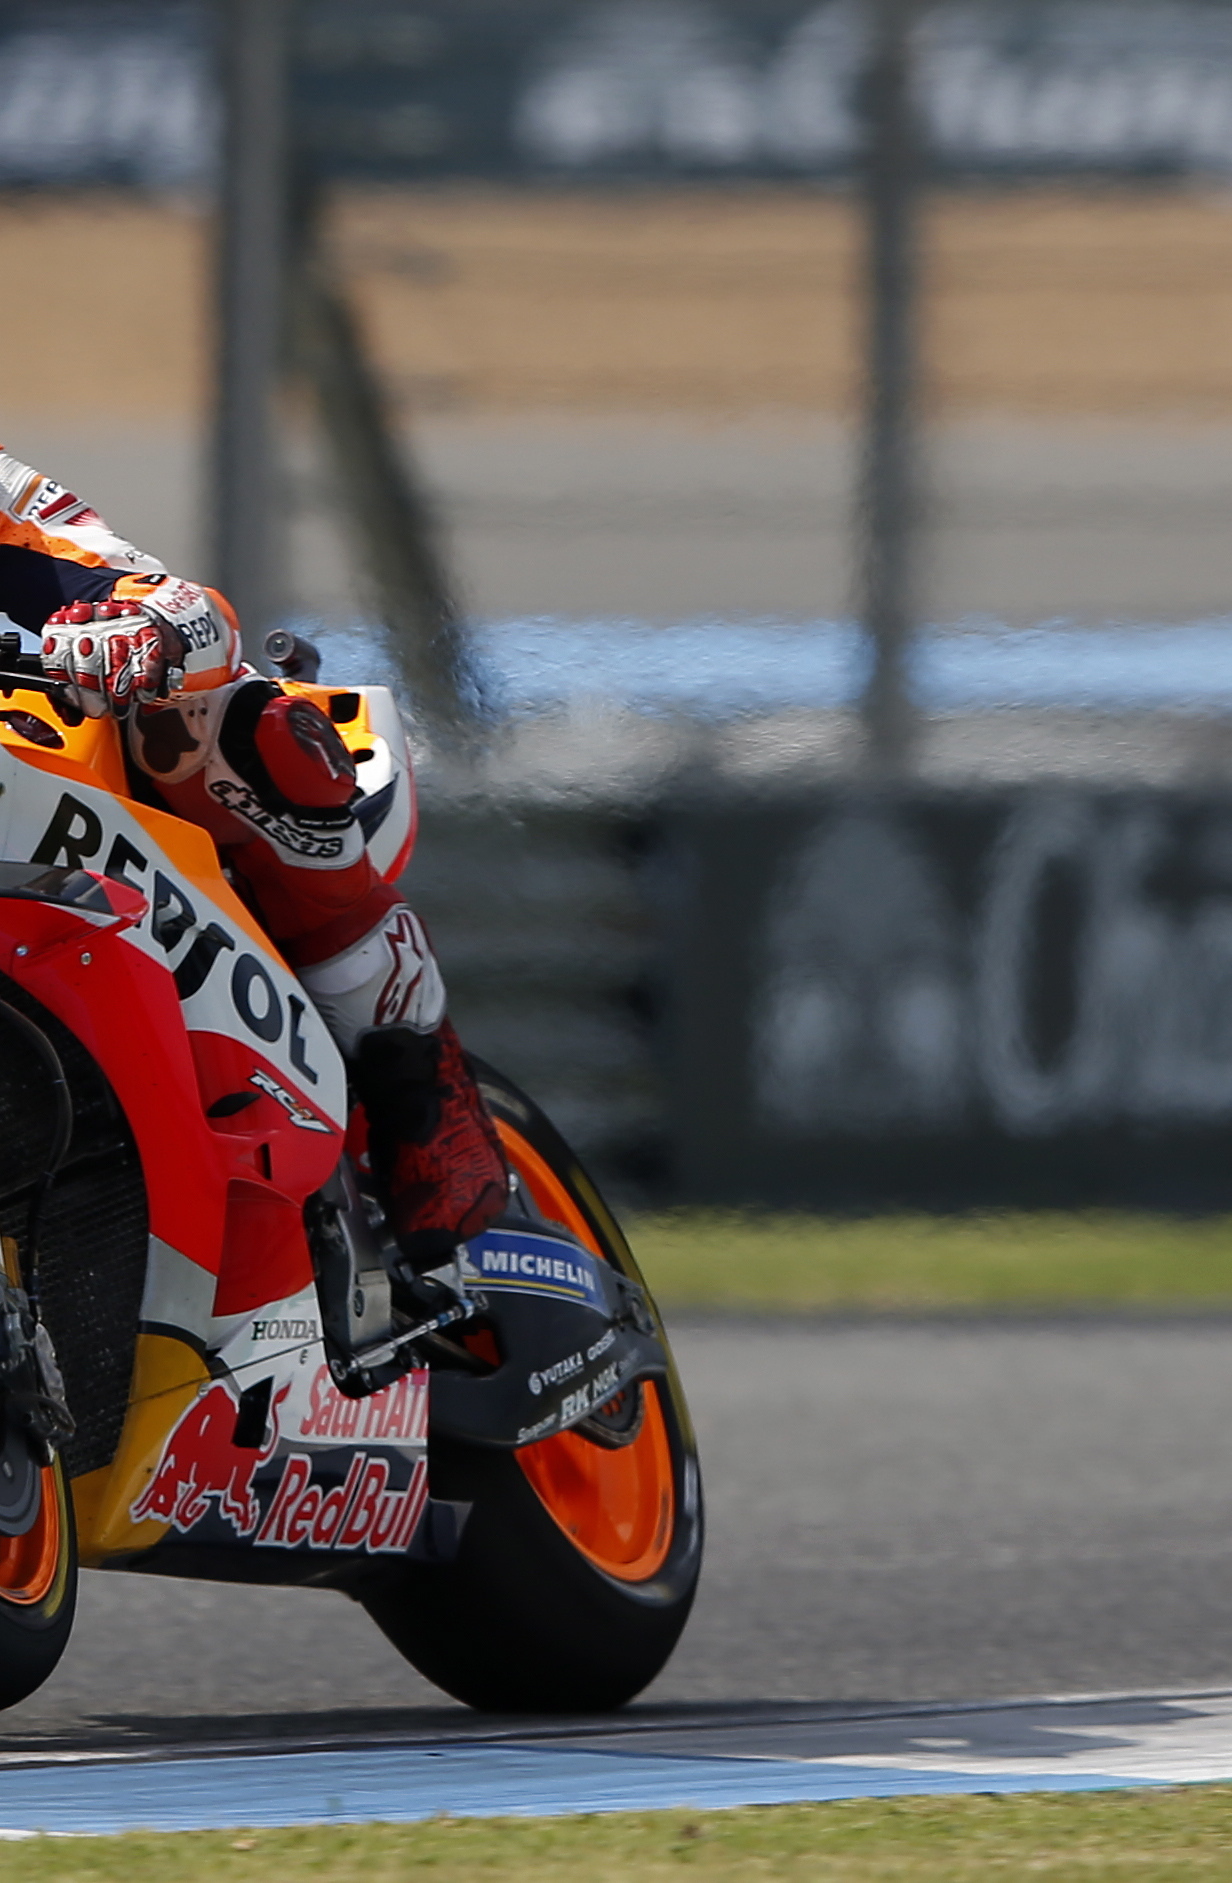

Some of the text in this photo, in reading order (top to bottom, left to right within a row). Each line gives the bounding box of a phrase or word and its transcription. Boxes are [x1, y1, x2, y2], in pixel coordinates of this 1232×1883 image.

[481, 1250, 596, 1293] MICHELIN
[251, 1319, 319, 1341] HONDA
[539, 1351, 584, 1386] YUTAKA
